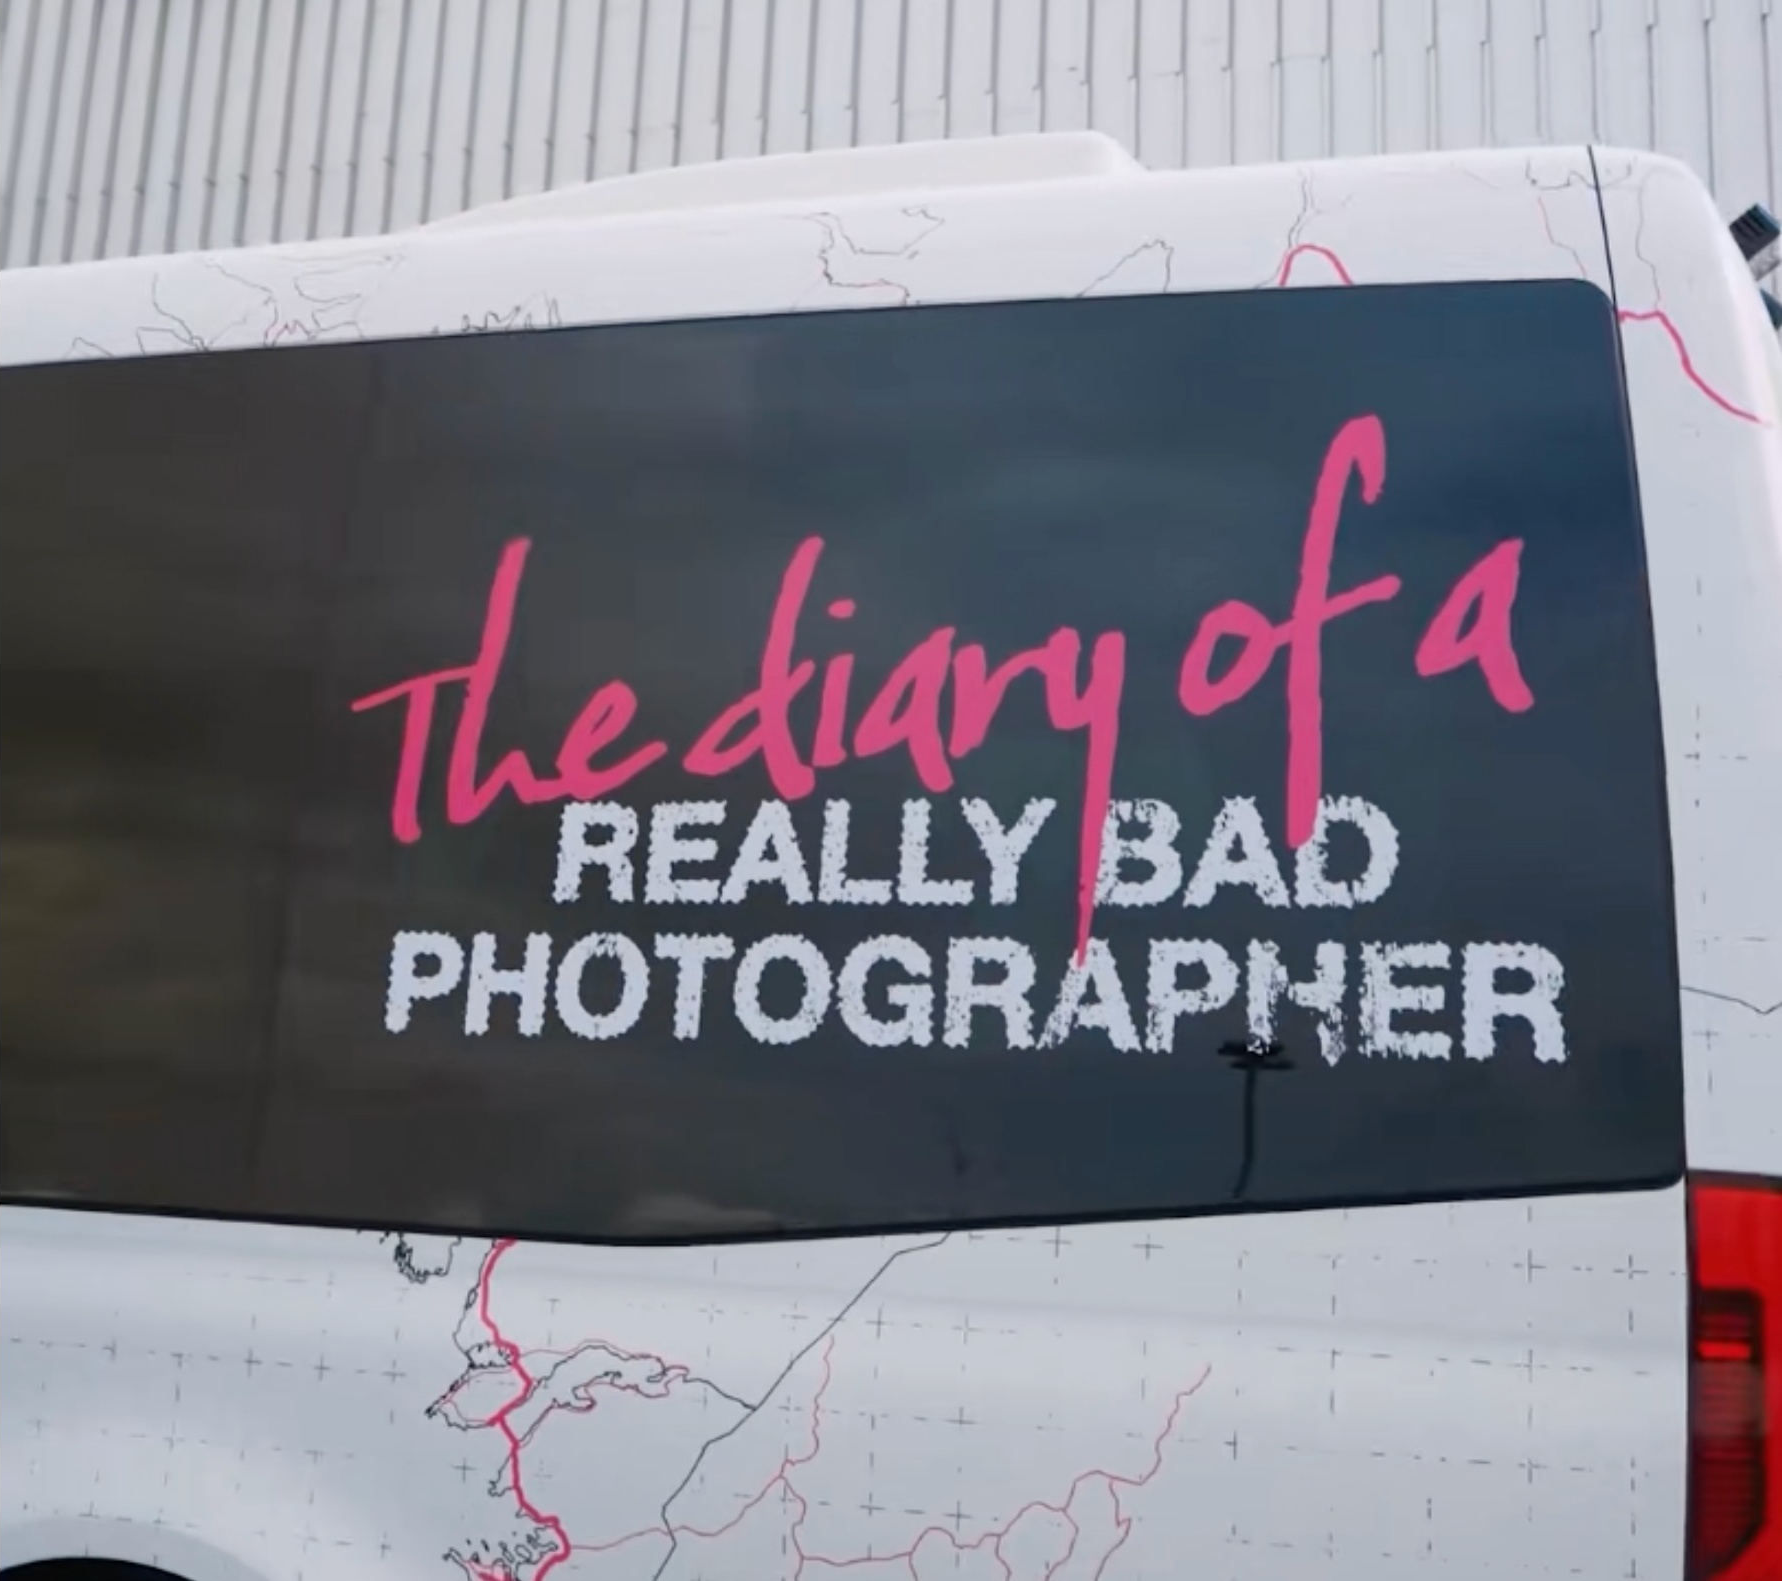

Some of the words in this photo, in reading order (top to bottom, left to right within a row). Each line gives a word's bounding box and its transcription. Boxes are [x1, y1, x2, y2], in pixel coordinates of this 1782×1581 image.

[352, 538, 666, 843] The
[682, 536, 1125, 964] diary
[1178, 415, 1399, 848] of
[1415, 540, 1532, 712] a
[553, 798, 1057, 905] REALLY
[1088, 795, 1400, 908] BAD
[384, 930, 1566, 1067] PHOTOGRAPHER
